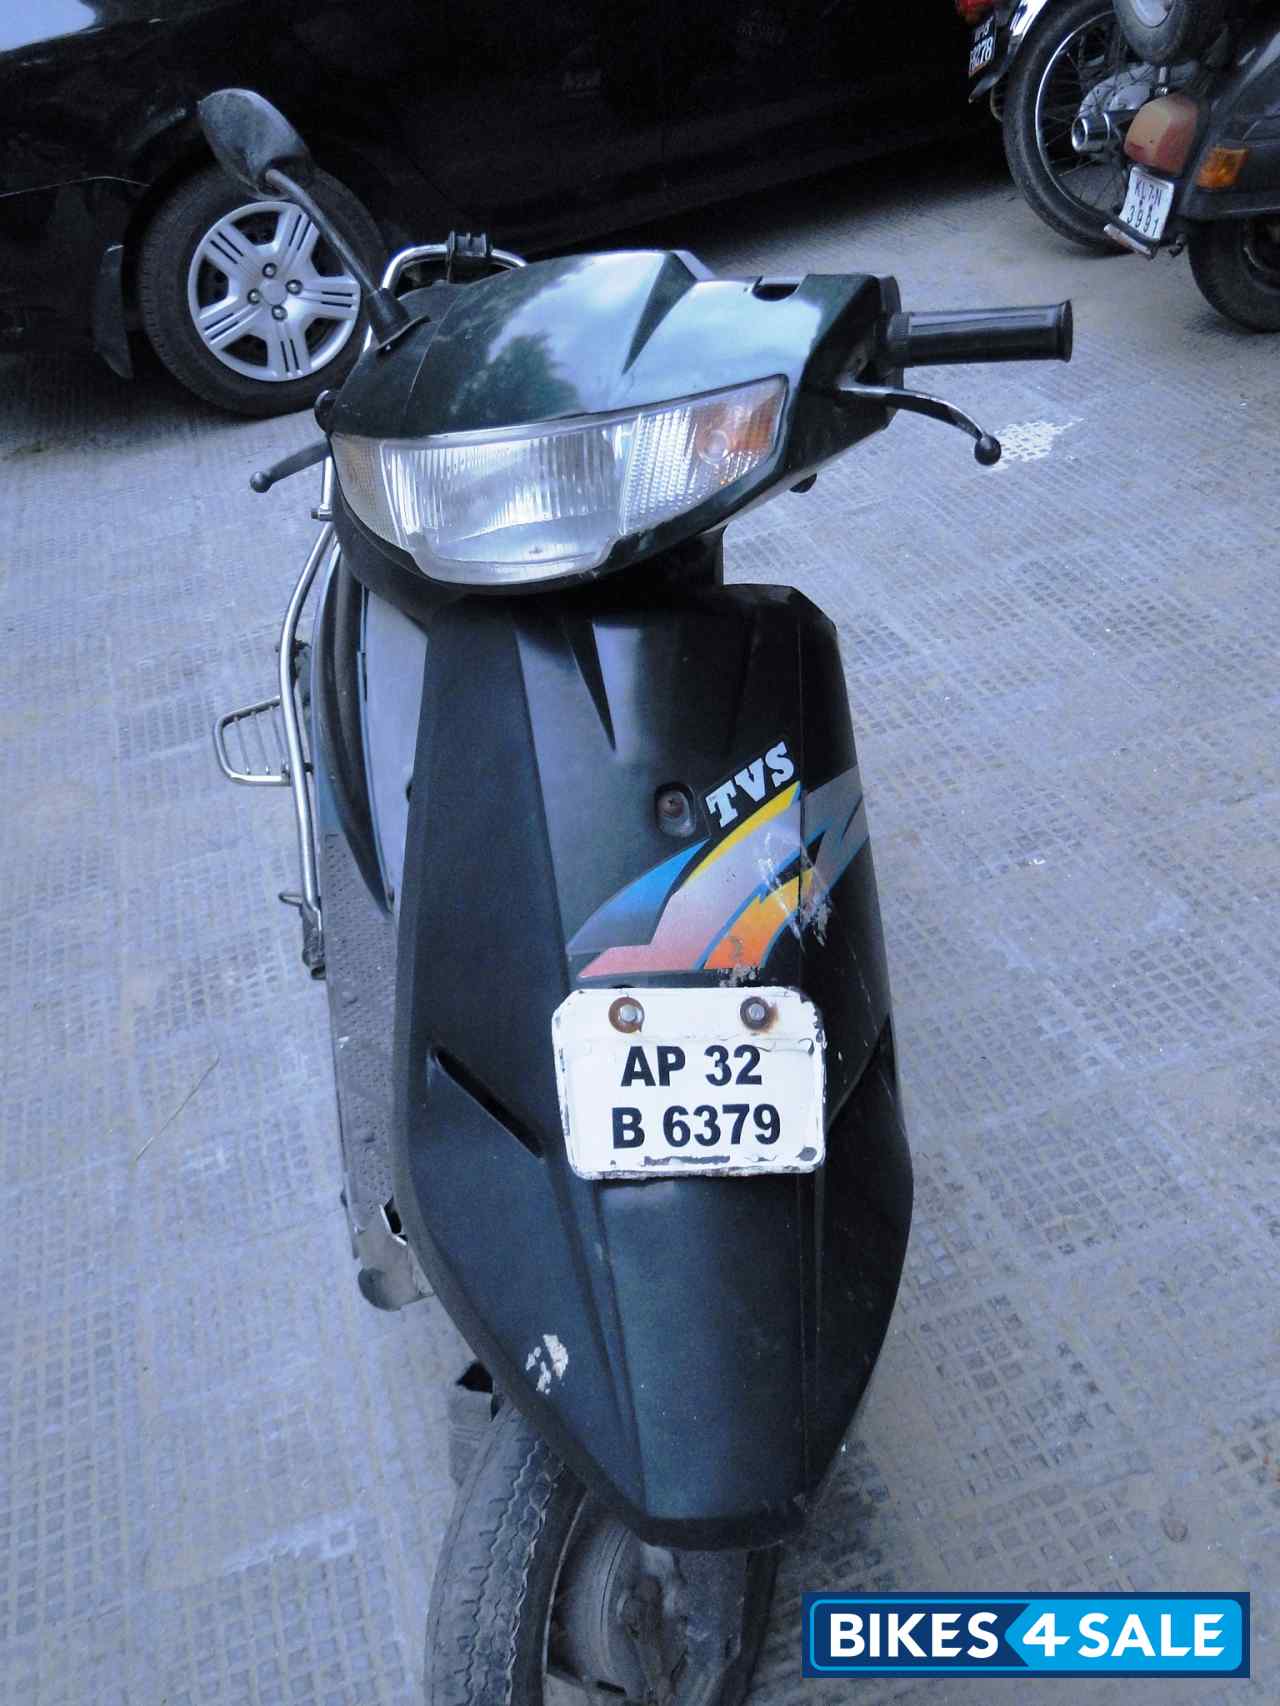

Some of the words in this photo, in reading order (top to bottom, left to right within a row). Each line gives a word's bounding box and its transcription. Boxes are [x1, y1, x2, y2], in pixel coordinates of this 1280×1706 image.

[705, 741, 795, 828] TVS
[620, 1045, 686, 1087] AP
[704, 1044, 762, 1087] 32
[611, 1106, 645, 1149] B
[662, 1103, 781, 1148] 6379
